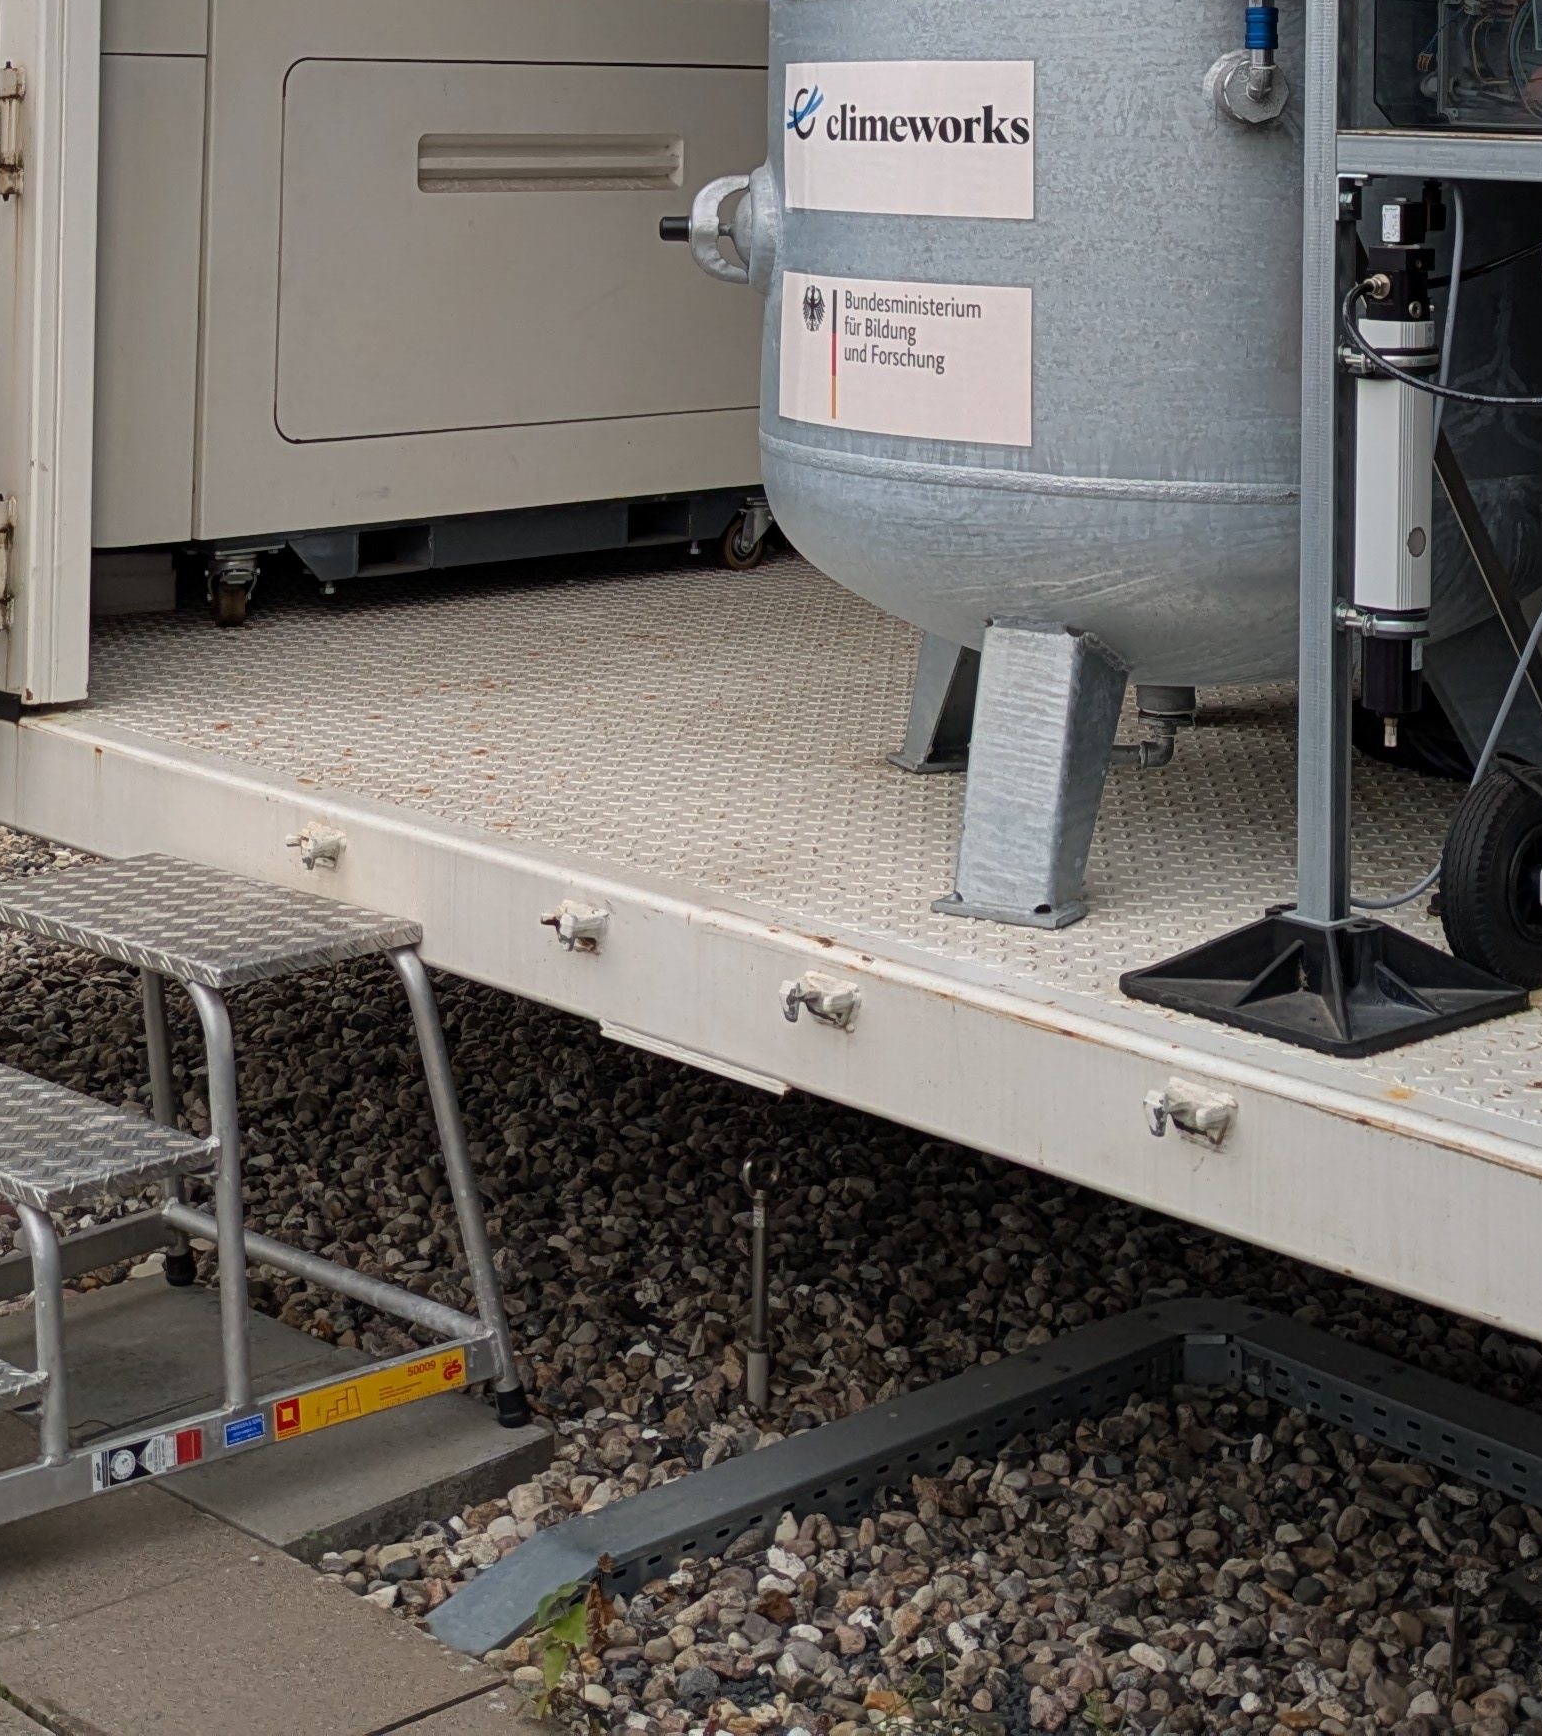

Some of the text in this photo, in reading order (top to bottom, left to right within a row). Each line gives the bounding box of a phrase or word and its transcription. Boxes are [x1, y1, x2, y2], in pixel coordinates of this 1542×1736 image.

[826, 104, 1030, 146] climeworks
[844, 291, 982, 319] Bundesministerium
[844, 315, 917, 346] für Bildung
[843, 343, 945, 375] und Forschung
[407, 1360, 437, 1377] 50009
